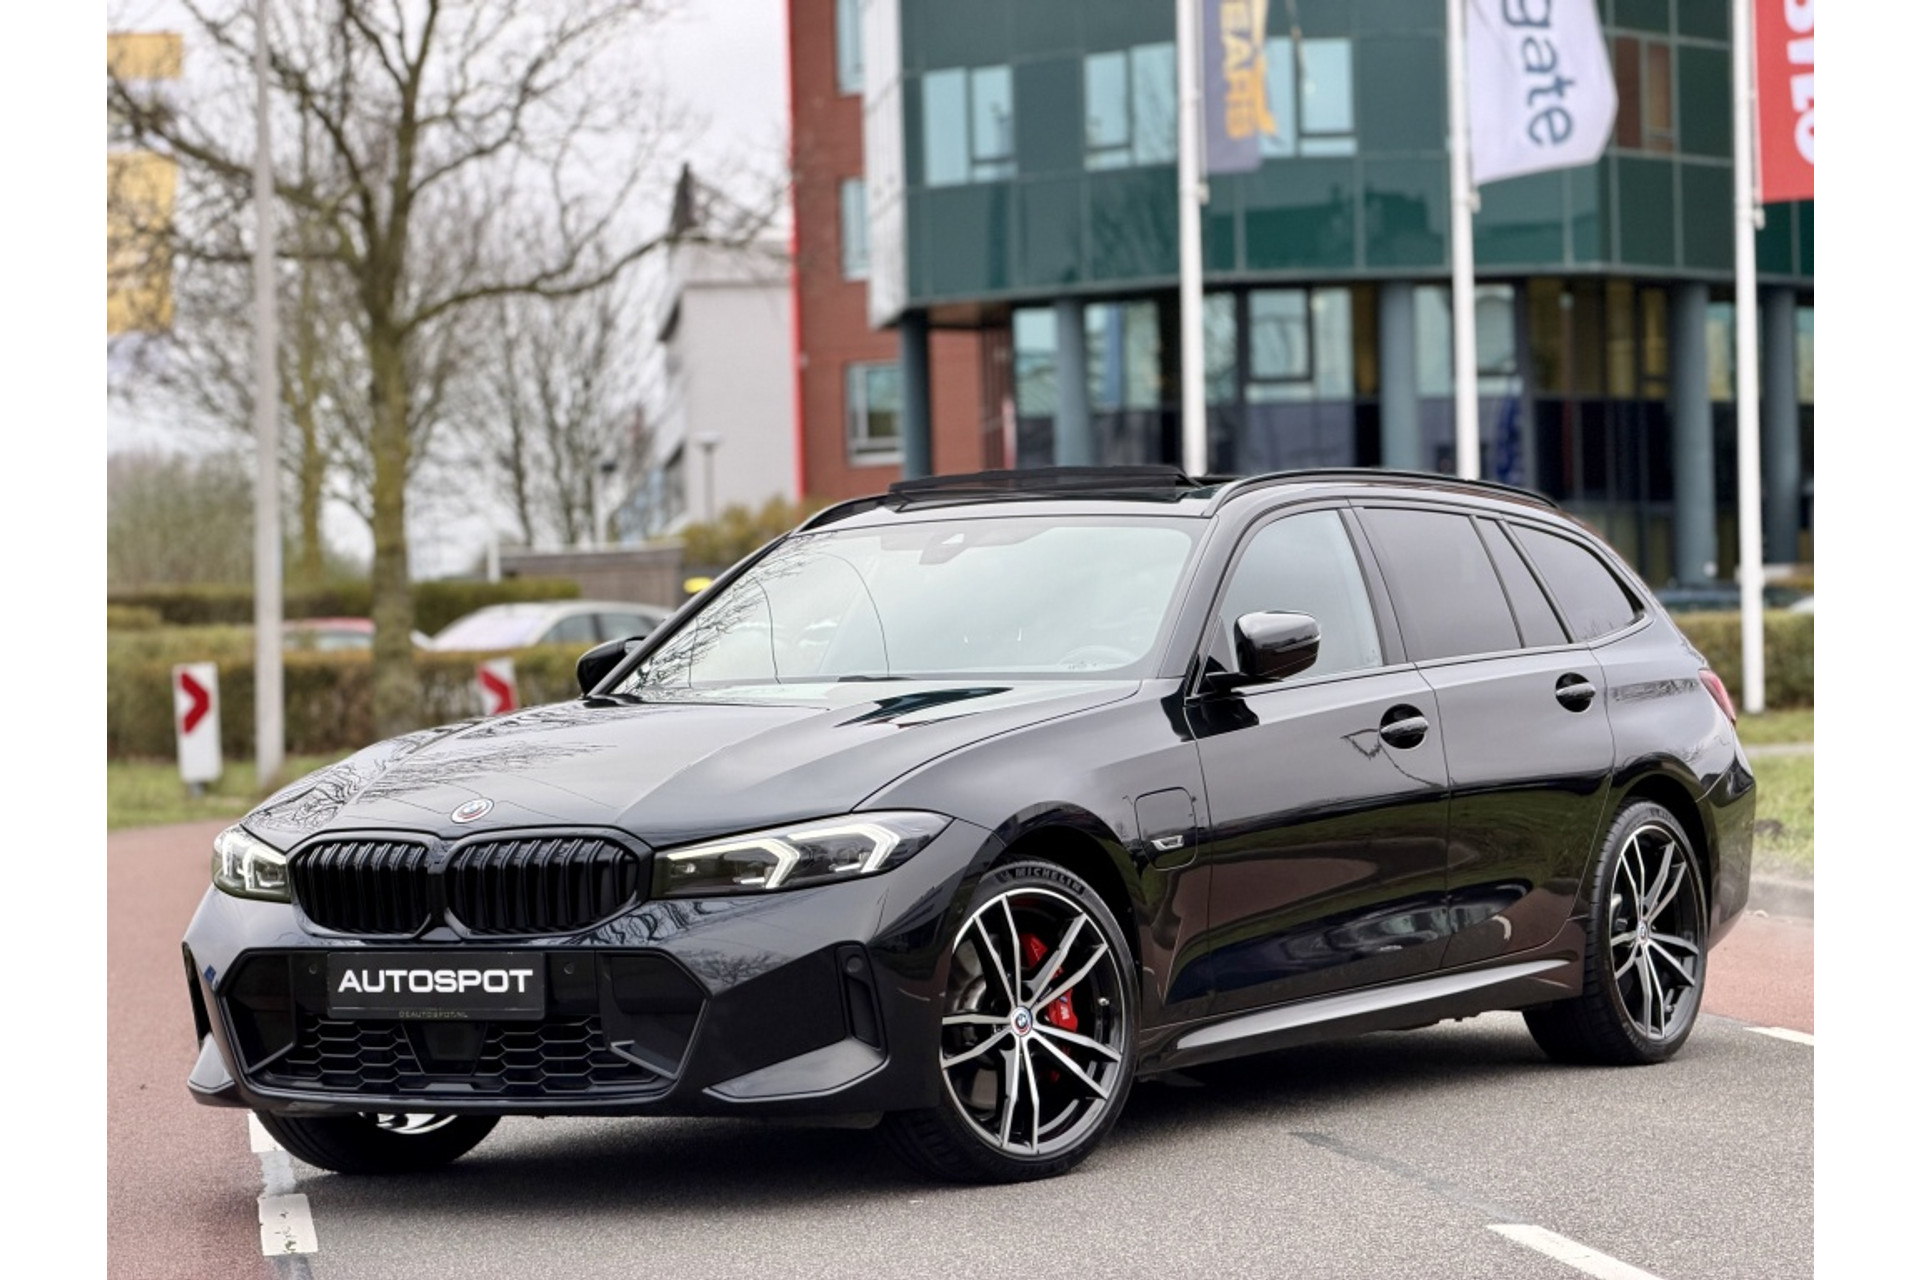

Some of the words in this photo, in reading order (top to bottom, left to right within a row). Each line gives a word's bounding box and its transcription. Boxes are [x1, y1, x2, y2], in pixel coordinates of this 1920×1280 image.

[1502, 0, 1575, 146] gate
[1015, 868, 1081, 892] MICHELIN
[338, 969, 533, 993] AUTOSPOT
